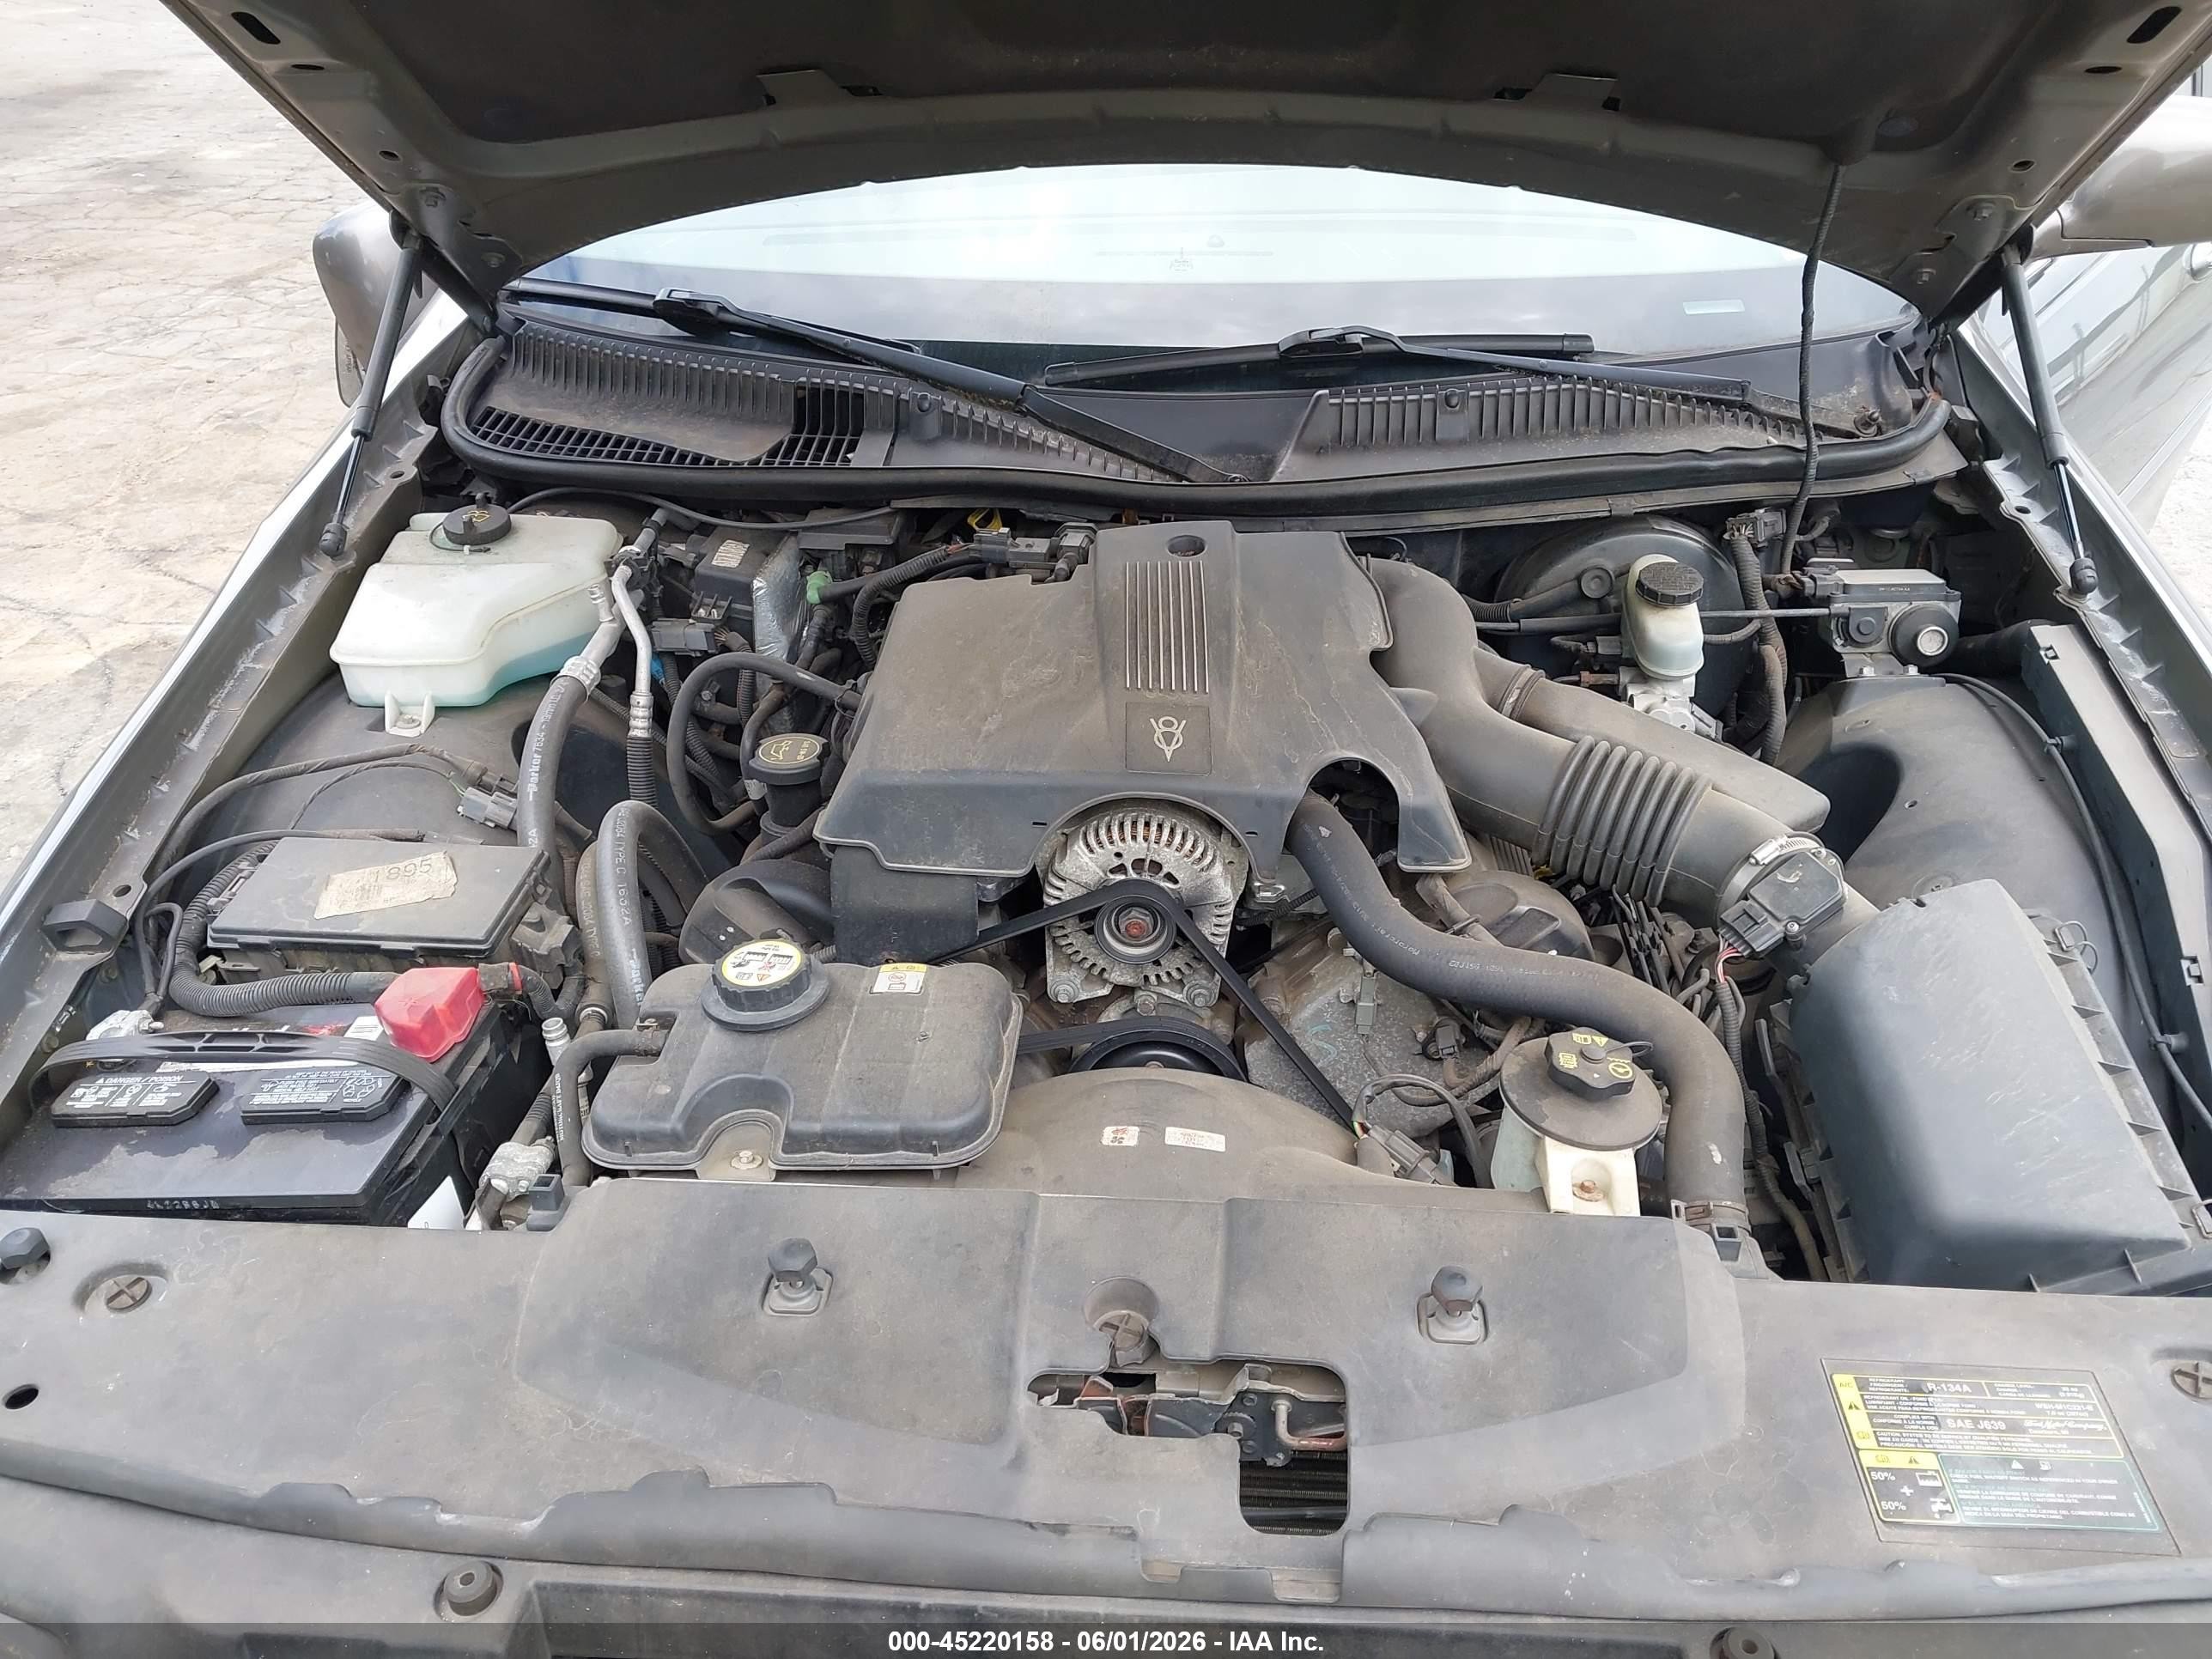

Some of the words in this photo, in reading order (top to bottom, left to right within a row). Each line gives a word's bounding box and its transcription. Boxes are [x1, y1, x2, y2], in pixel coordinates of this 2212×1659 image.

[1926, 1382, 1972, 1395] R-134A
[1947, 1418, 1973, 1430] SAE
[1977, 1419, 2007, 1431] J639
[1870, 1471, 1896, 1481] 50%
[1881, 1500, 1907, 1511] 50%
